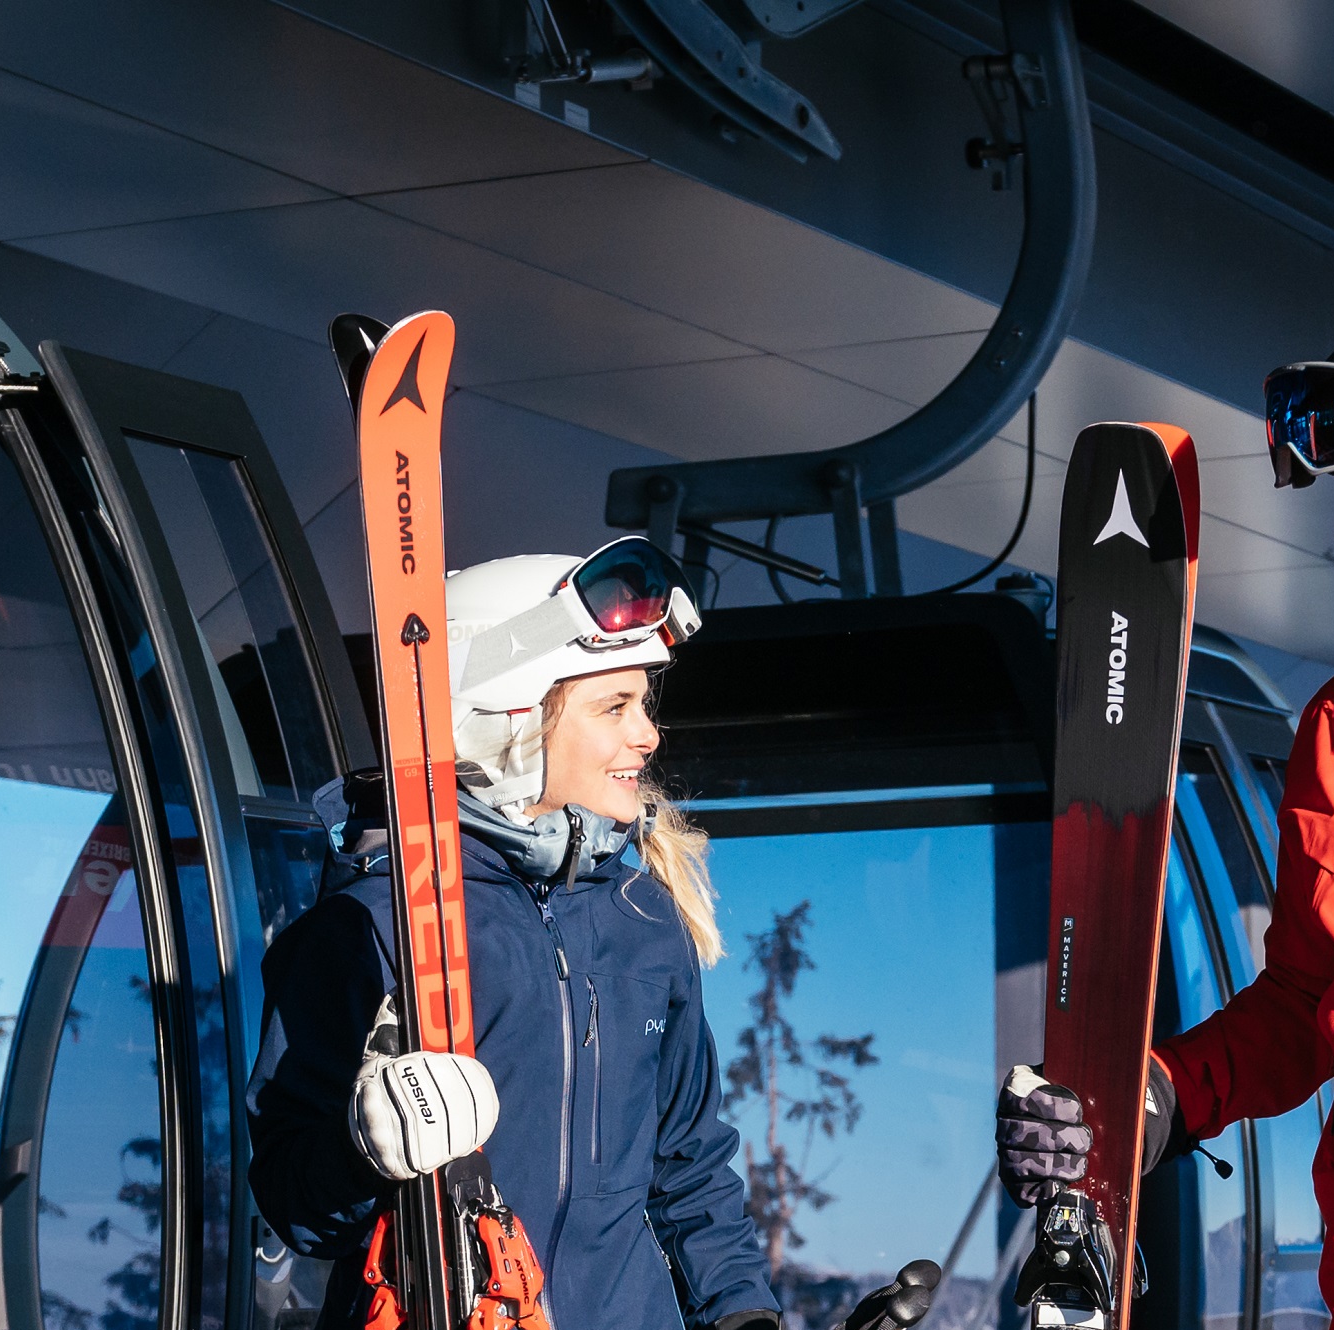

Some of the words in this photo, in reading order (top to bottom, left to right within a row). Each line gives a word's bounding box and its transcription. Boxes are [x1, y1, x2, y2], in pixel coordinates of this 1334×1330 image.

[395, 449, 416, 575] ATOMIC
[1105, 610, 1129, 725] ATOMIC
[1060, 936, 1071, 1003] MAVERICK
[402, 1066, 436, 1124] reusch
[514, 1258, 530, 1305] ATOMIC
